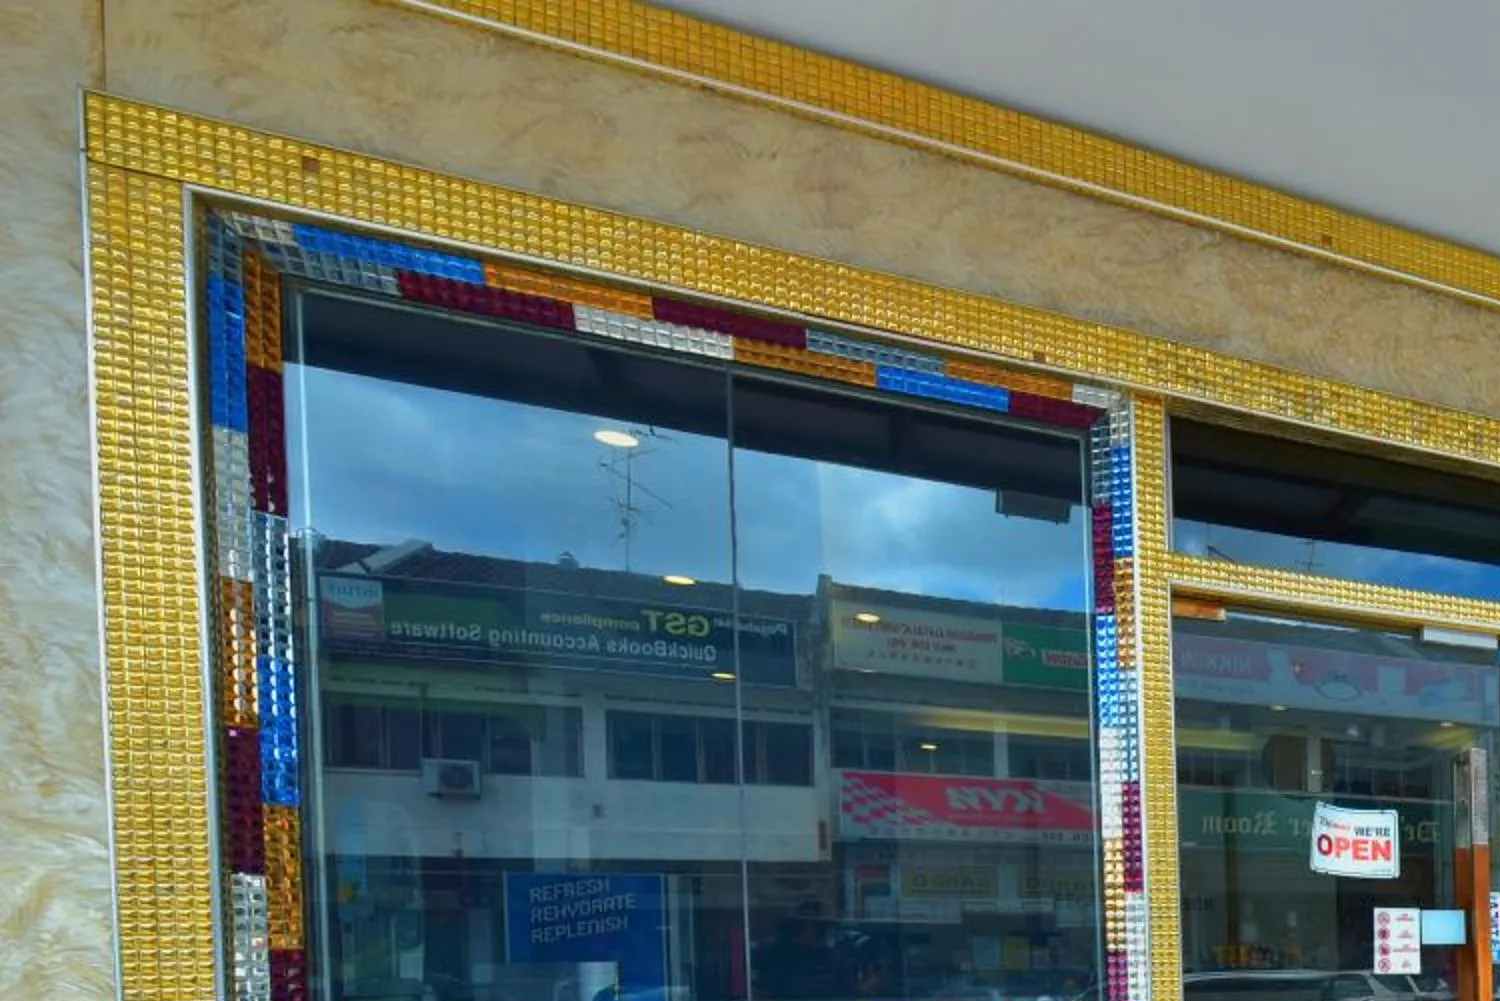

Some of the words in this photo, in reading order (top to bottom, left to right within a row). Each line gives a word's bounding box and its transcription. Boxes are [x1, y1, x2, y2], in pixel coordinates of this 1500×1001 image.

[1317, 834, 1392, 861] OPEN
[530, 878, 610, 903] REFRESH
[530, 892, 637, 923] REHYDRATE
[531, 914, 628, 944] REPLENISH
